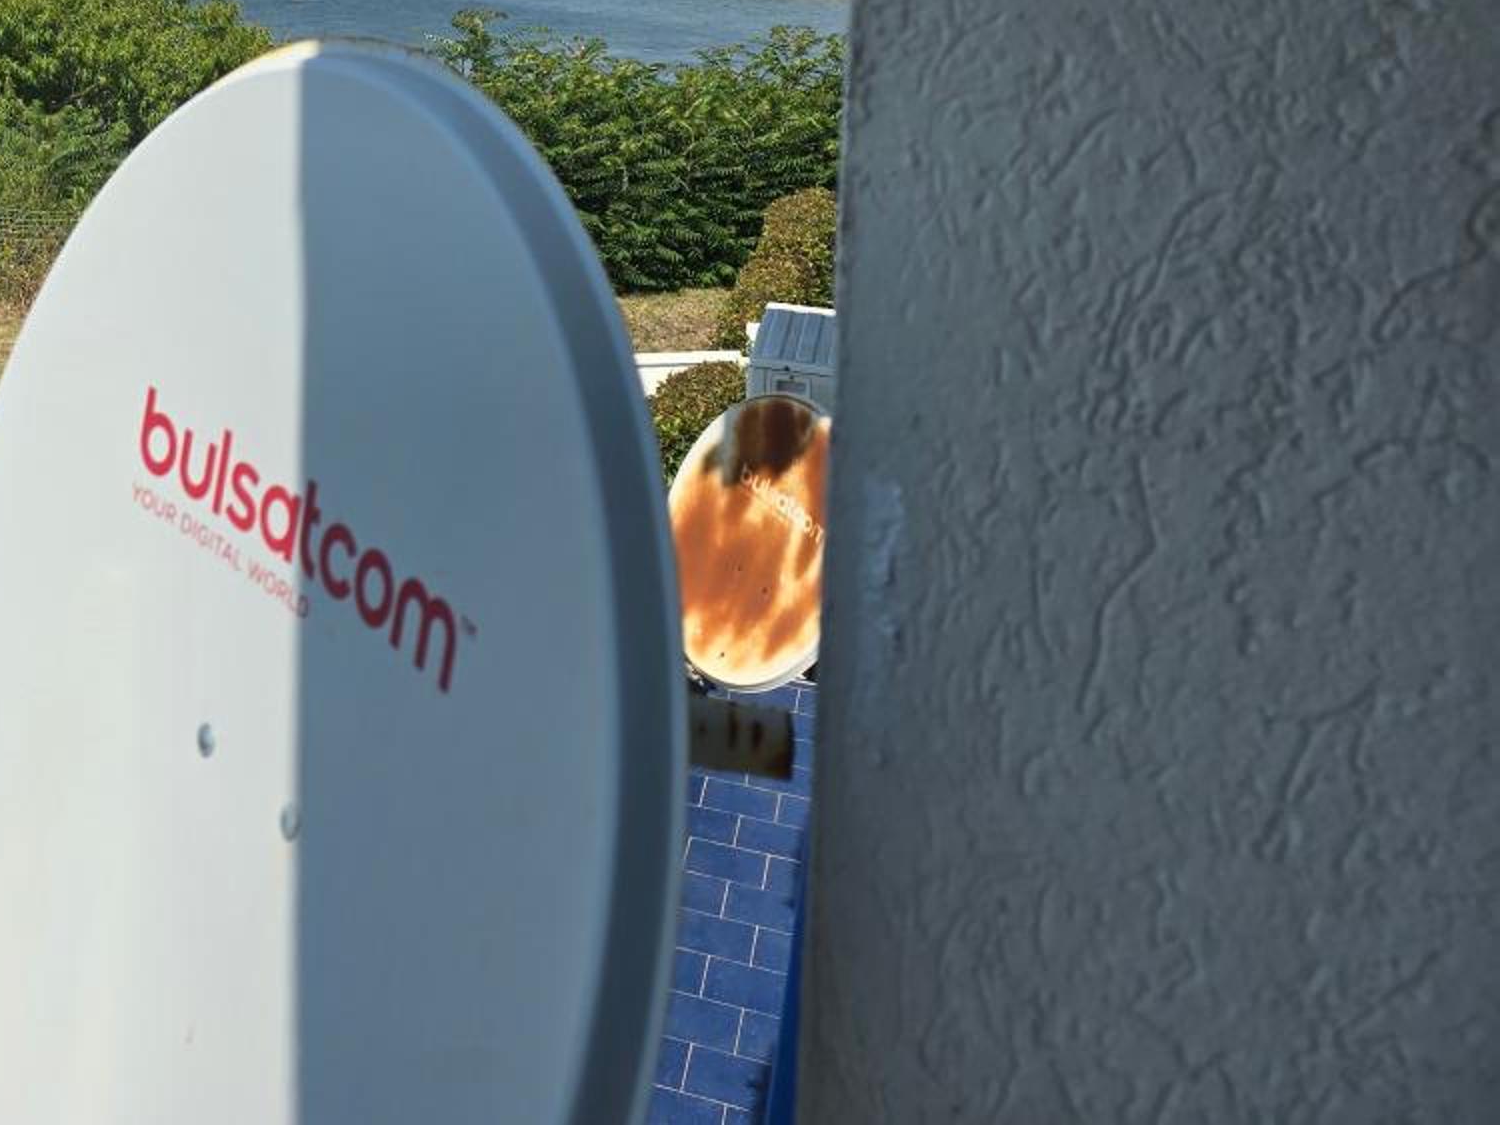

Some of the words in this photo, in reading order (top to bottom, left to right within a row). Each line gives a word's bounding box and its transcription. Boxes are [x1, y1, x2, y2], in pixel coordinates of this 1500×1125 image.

[132, 485, 178, 523] YOUR
[180, 512, 243, 572] DIGITAL
[249, 563, 309, 618] WORLD
[141, 386, 457, 694] bulsatcom
